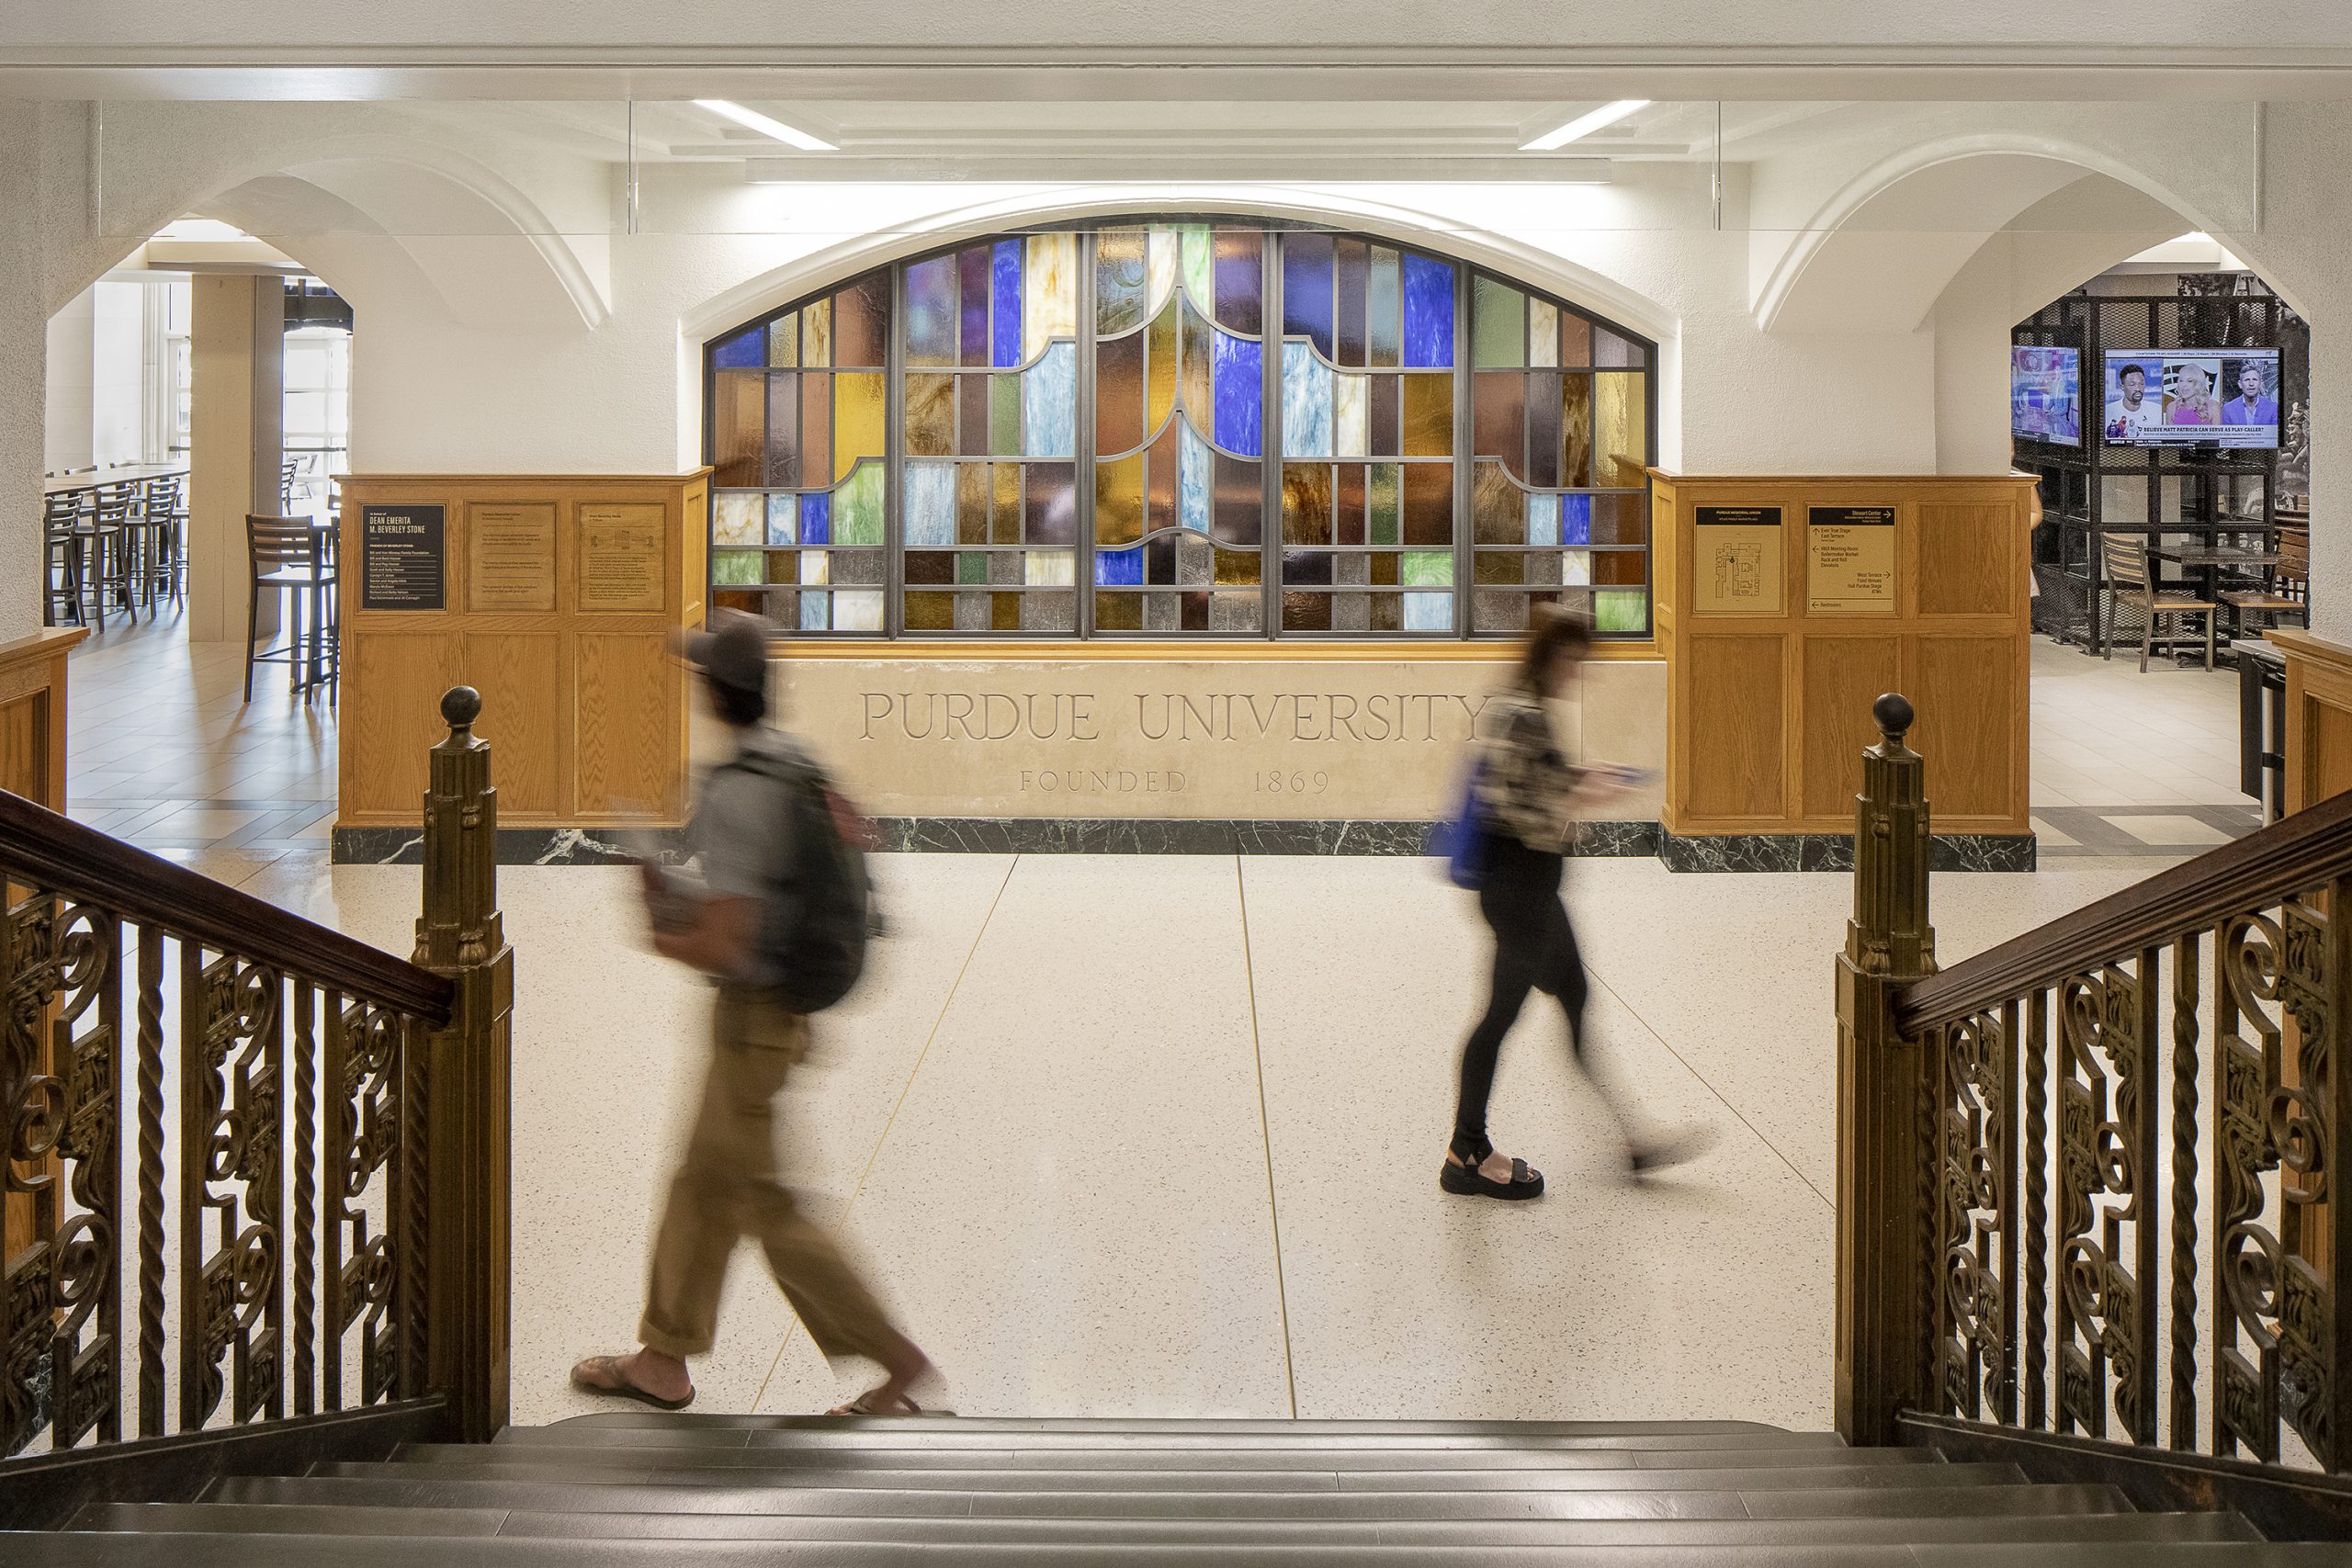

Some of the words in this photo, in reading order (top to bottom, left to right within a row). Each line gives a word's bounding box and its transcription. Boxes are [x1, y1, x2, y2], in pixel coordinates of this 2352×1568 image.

[369, 516, 385, 525] DEAN
[387, 516, 412, 525] EMERITA
[369, 525, 377, 534] M.
[378, 525, 405, 534] BEVERLEY
[407, 525, 425, 534] STONE
[858, 693, 1101, 741] PURDUE
[1135, 693, 1495, 741] UNIVERSITY
[1019, 770, 1186, 794] FOUNDED
[1253, 770, 1330, 794] 1869
